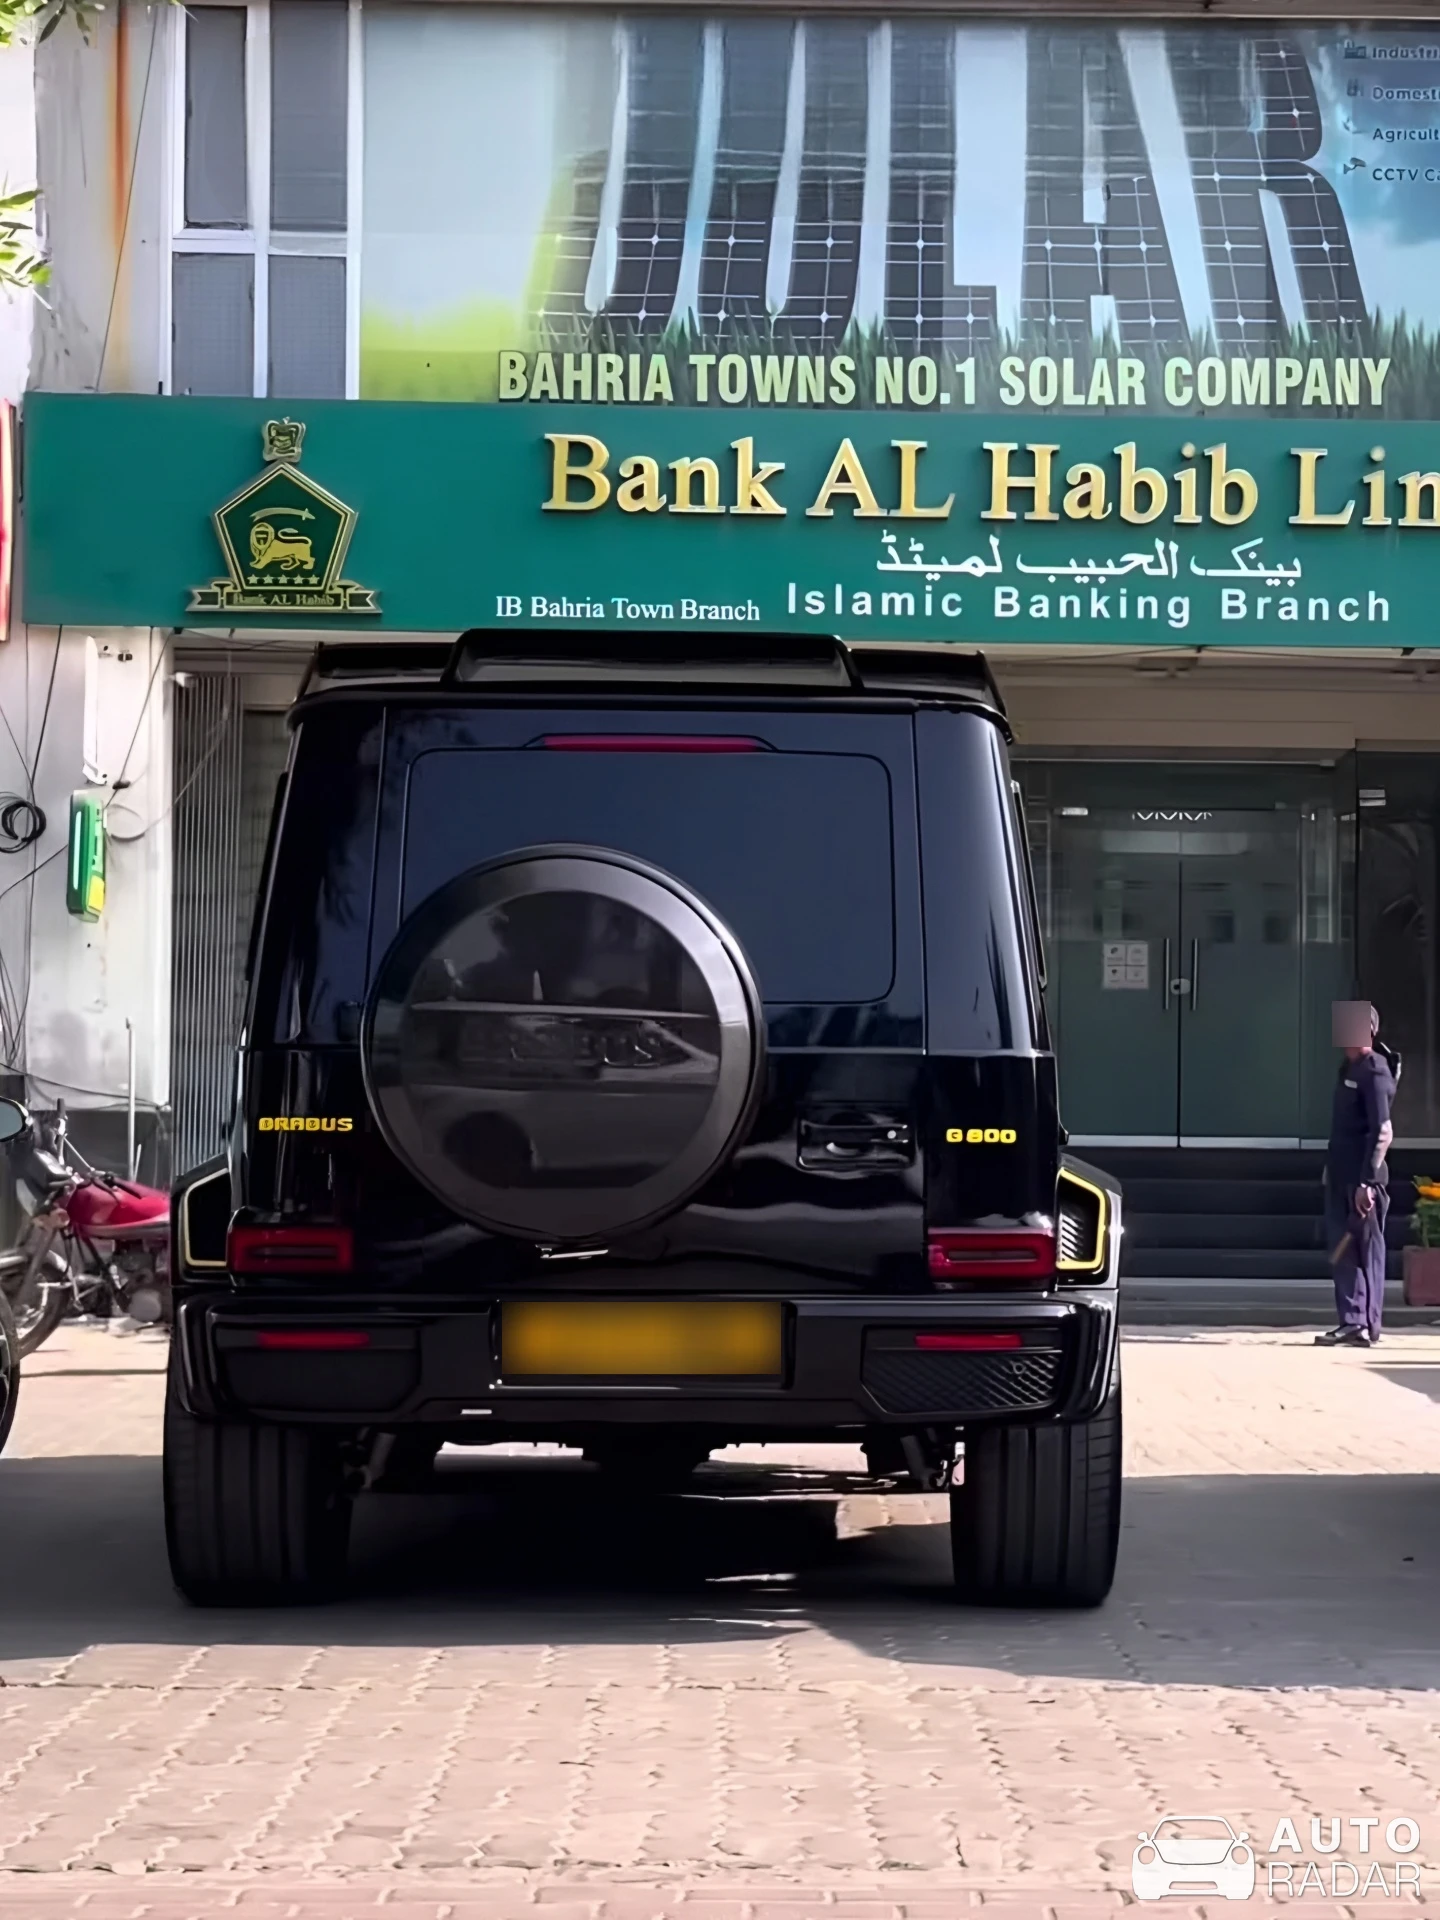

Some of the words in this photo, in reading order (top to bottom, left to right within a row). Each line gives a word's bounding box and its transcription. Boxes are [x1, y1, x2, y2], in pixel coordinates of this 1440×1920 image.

[1373, 87, 1440, 100] Domest
[1373, 168, 1418, 181] CCTV
[499, 351, 674, 401] BAHRIA
[690, 353, 856, 403] TOWNS
[875, 355, 976, 406] NO.1
[999, 356, 1146, 406] SOLAR
[1164, 357, 1391, 406] COMPANY
[541, 433, 787, 515] Bank
[805, 437, 956, 518] AL
[980, 441, 1259, 525] Habib
[270, 594, 292, 605] AL
[495, 595, 522, 617] IB
[530, 596, 605, 618] Bahria
[611, 597, 674, 619] Town
[680, 599, 760, 621] Branch
[787, 582, 963, 617] Islamic
[993, 586, 1191, 629] Banking
[1221, 588, 1390, 622] Branch
[258, 1117, 353, 1132] BRABUS
